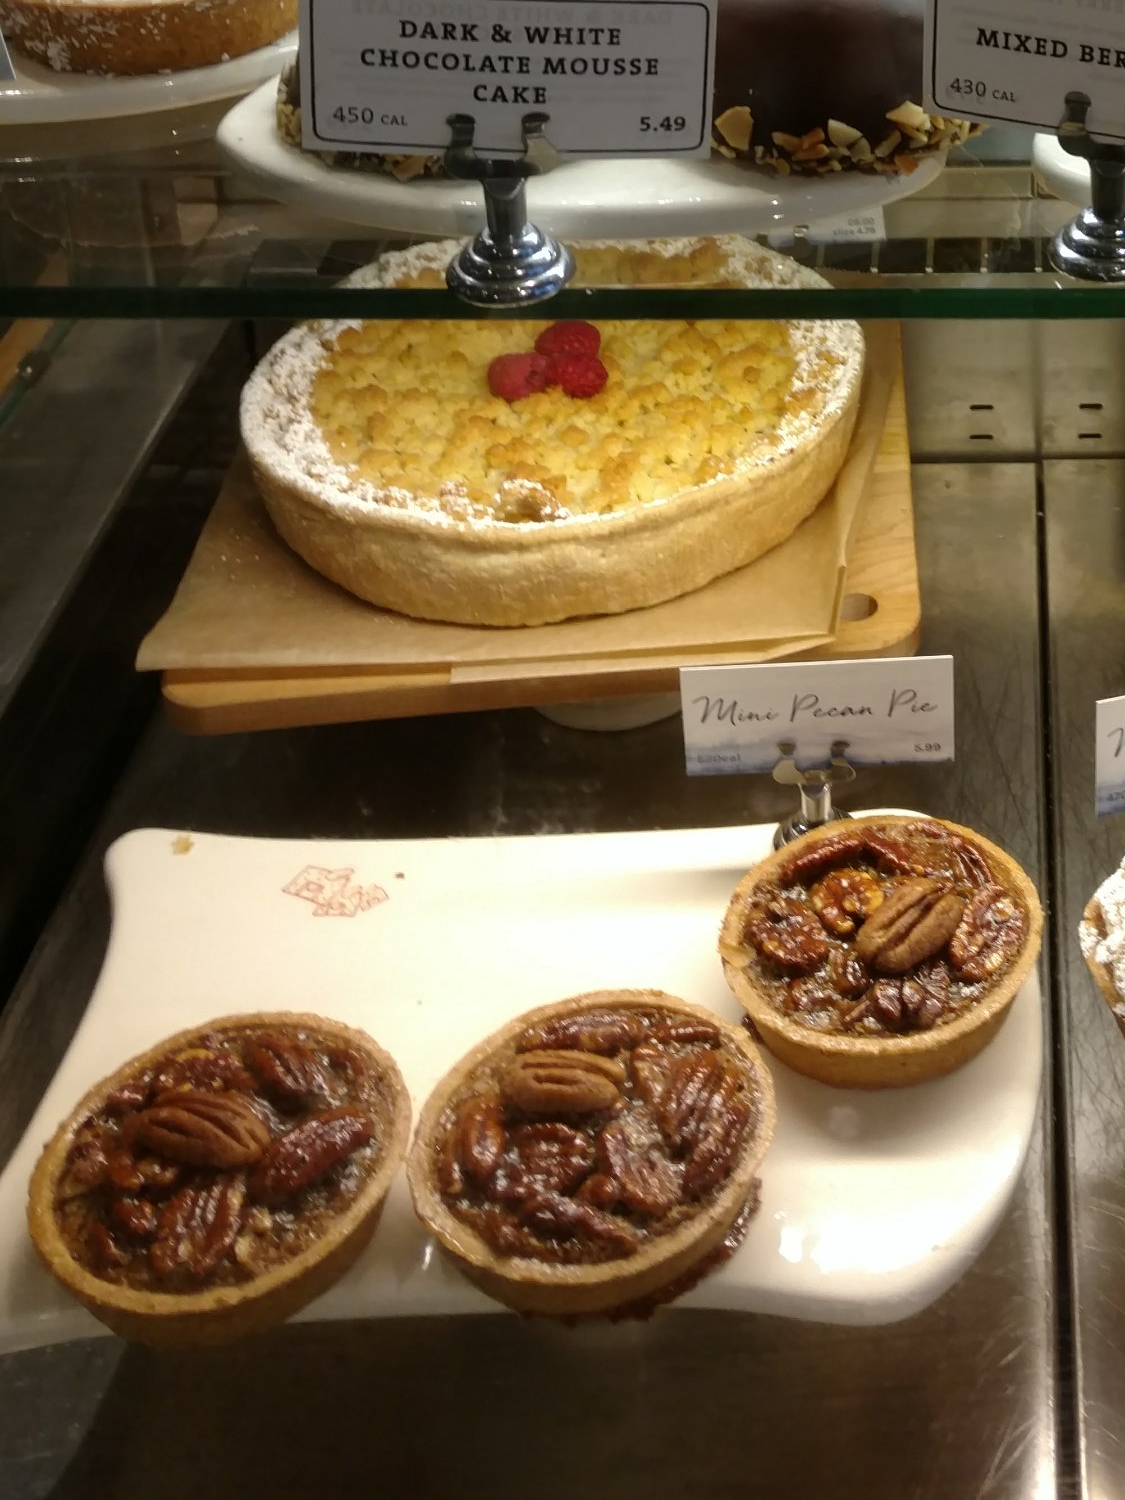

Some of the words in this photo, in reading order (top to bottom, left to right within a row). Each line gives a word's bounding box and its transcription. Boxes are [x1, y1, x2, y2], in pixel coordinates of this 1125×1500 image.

[399, 20, 480, 43] DARK
[491, 23, 512, 44] &
[524, 26, 622, 46] WHITE
[976, 27, 1069, 59] MIXED
[360, 48, 531, 74] CHOCOLATE
[542, 56, 660, 75] MOUSSE
[473, 84, 548, 104] CAKE
[949, 77, 986, 97] 430
[992, 89, 1016, 103] CAL
[332, 106, 374, 125] 450
[380, 114, 407, 127] CAL
[639, 116, 686, 133] 5.49
[691, 695, 780, 726] Mini
[789, 693, 874, 723] Pecan
[887, 688, 938, 717] Pie
